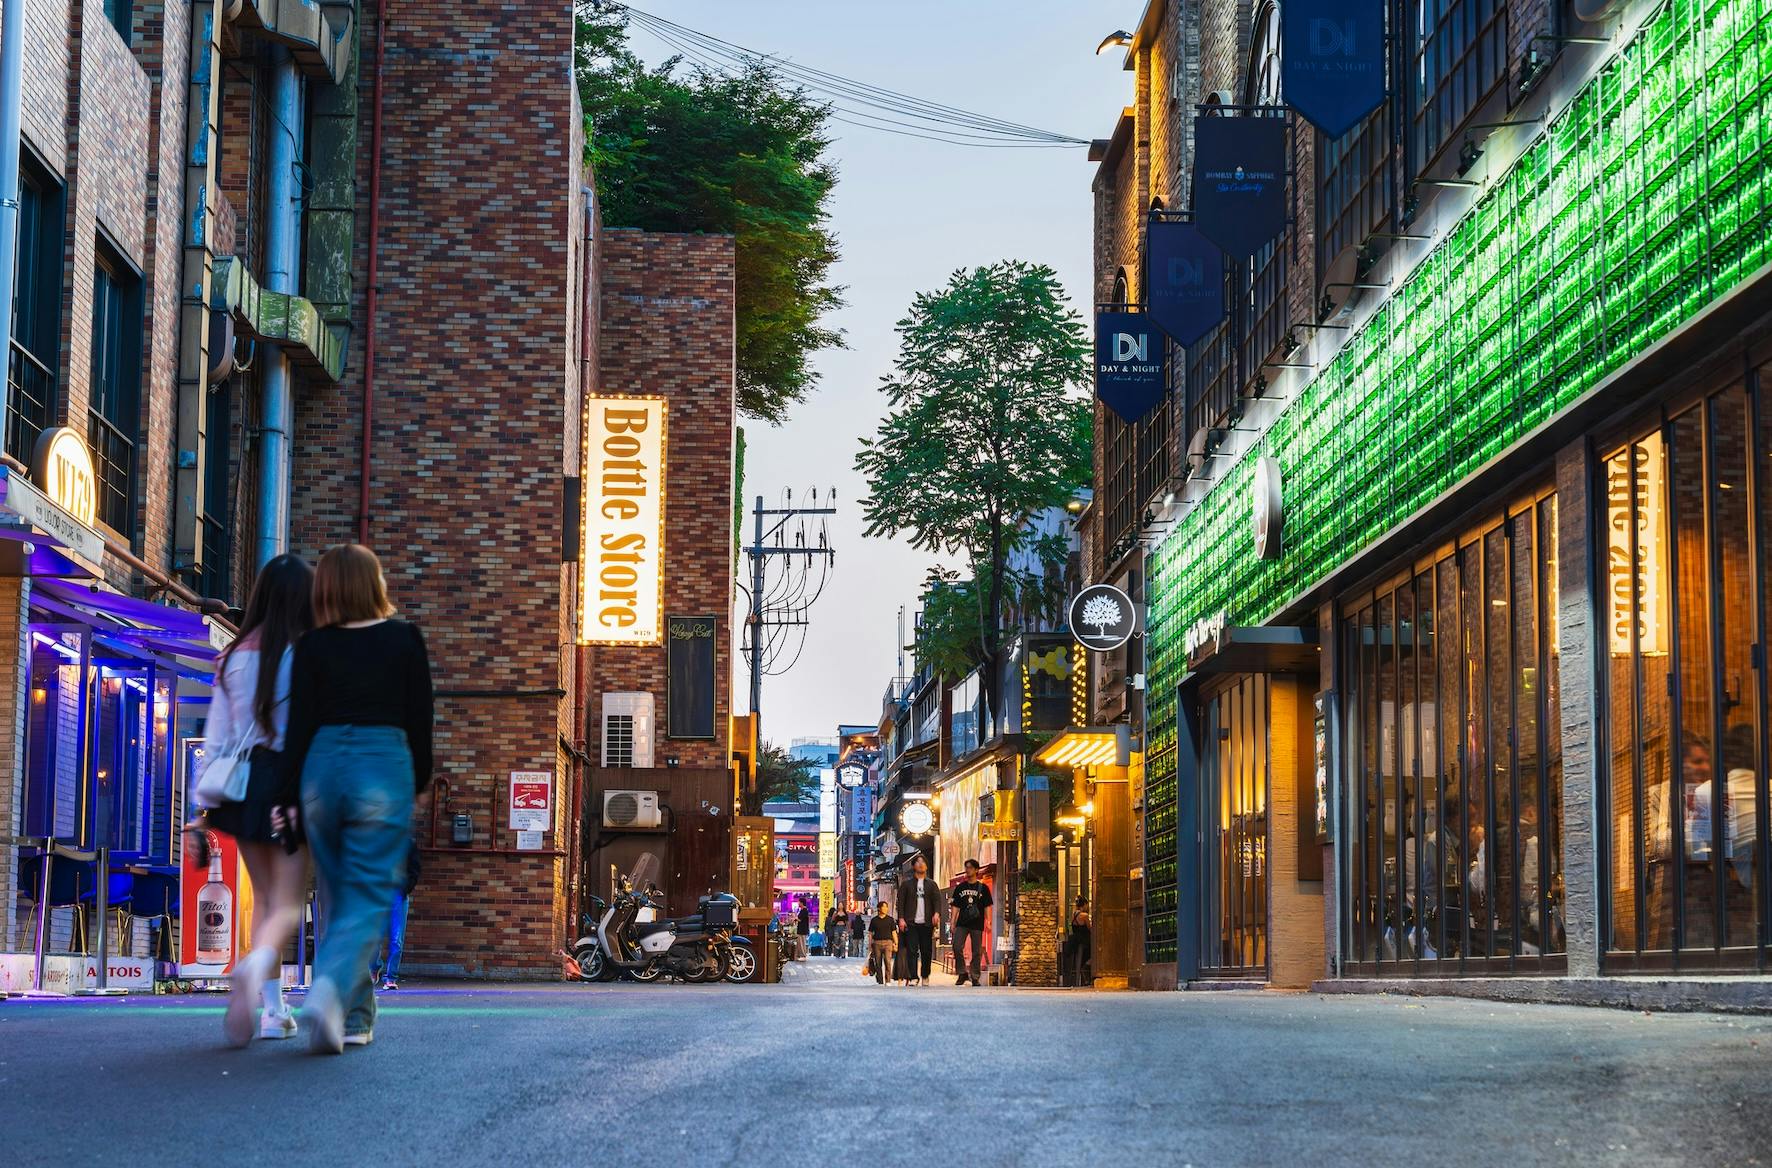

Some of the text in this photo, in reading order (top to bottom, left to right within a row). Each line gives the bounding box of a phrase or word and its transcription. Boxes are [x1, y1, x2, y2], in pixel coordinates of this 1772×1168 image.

[1294, 61, 1318, 72] DAY
[1336, 61, 1373, 72] NIGHT
[598, 407, 648, 627] Bottle Store
[44, 508, 60, 532] LIQUOR
[61, 519, 75, 541] STORE
[982, 828, 1020, 839] Atelier
[202, 902, 228, 911] Tito's
[86, 966, 142, 978] ATOIS
